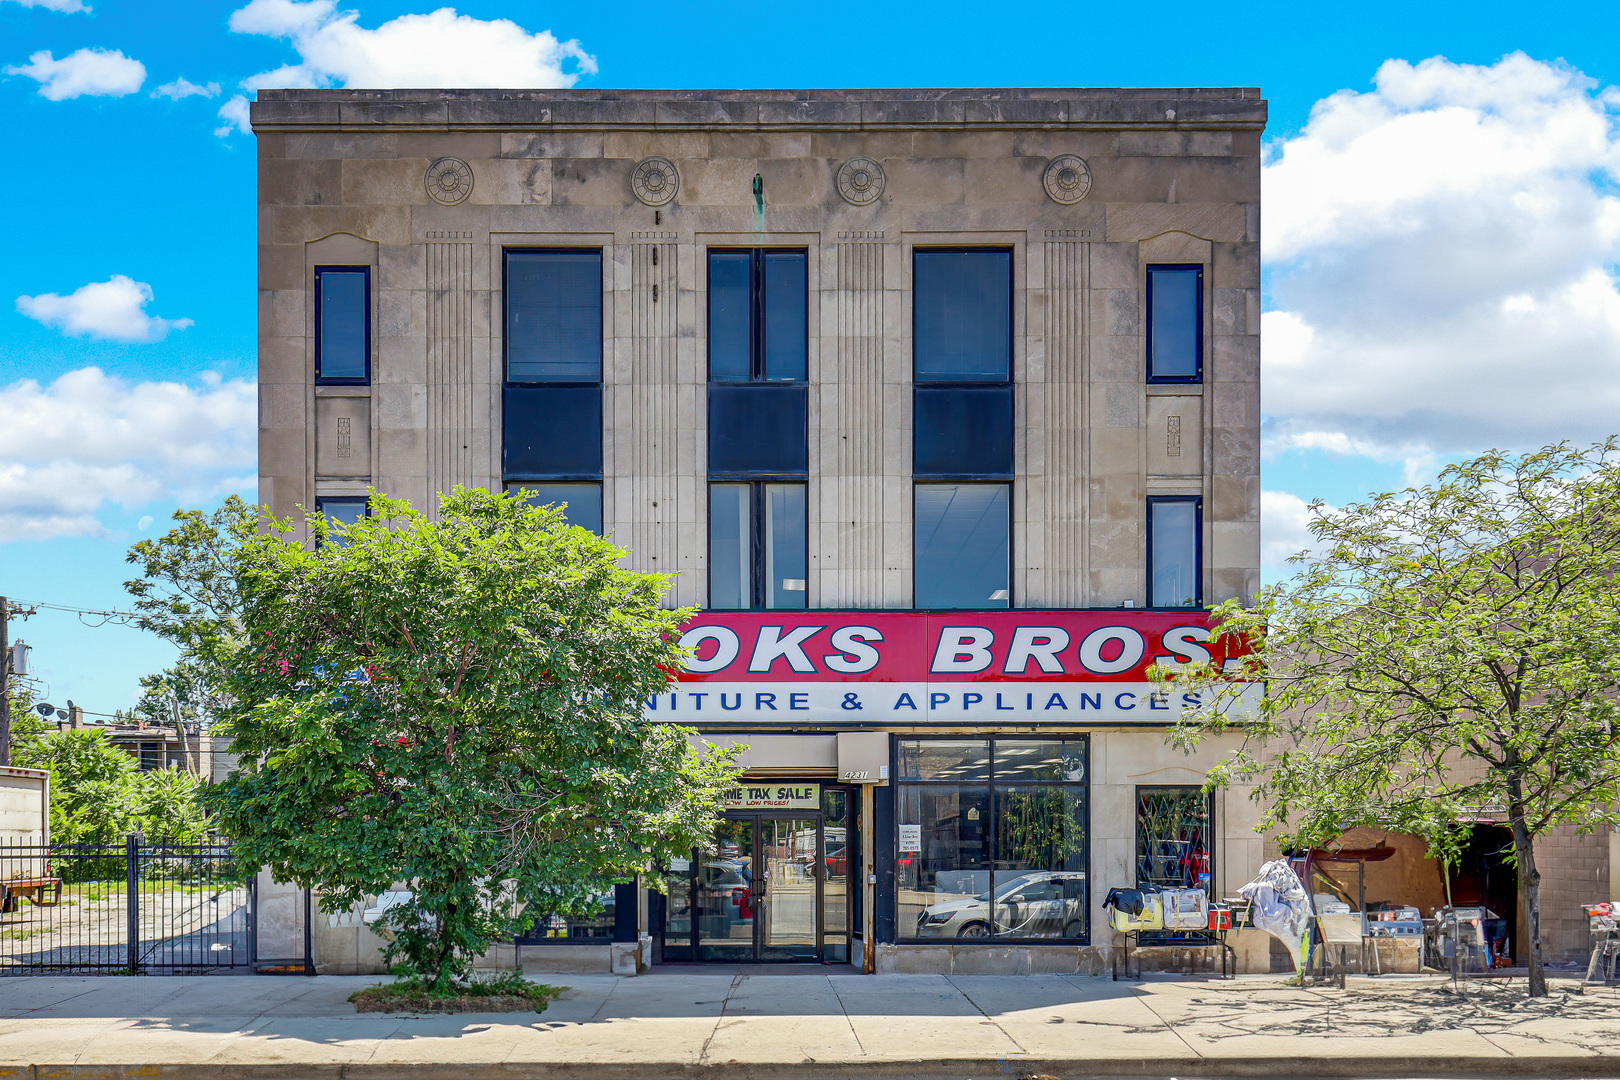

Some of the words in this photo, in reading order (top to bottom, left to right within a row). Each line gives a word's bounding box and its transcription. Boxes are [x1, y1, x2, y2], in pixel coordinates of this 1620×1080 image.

[677, 624, 885, 675] OKS
[637, 692, 810, 711] NITURE
[841, 692, 863, 711] &
[894, 692, 1202, 711] APPLIANCES
[845, 771, 867, 779] 4231
[747, 788, 771, 800] TAX
[777, 787, 813, 800] SALE
